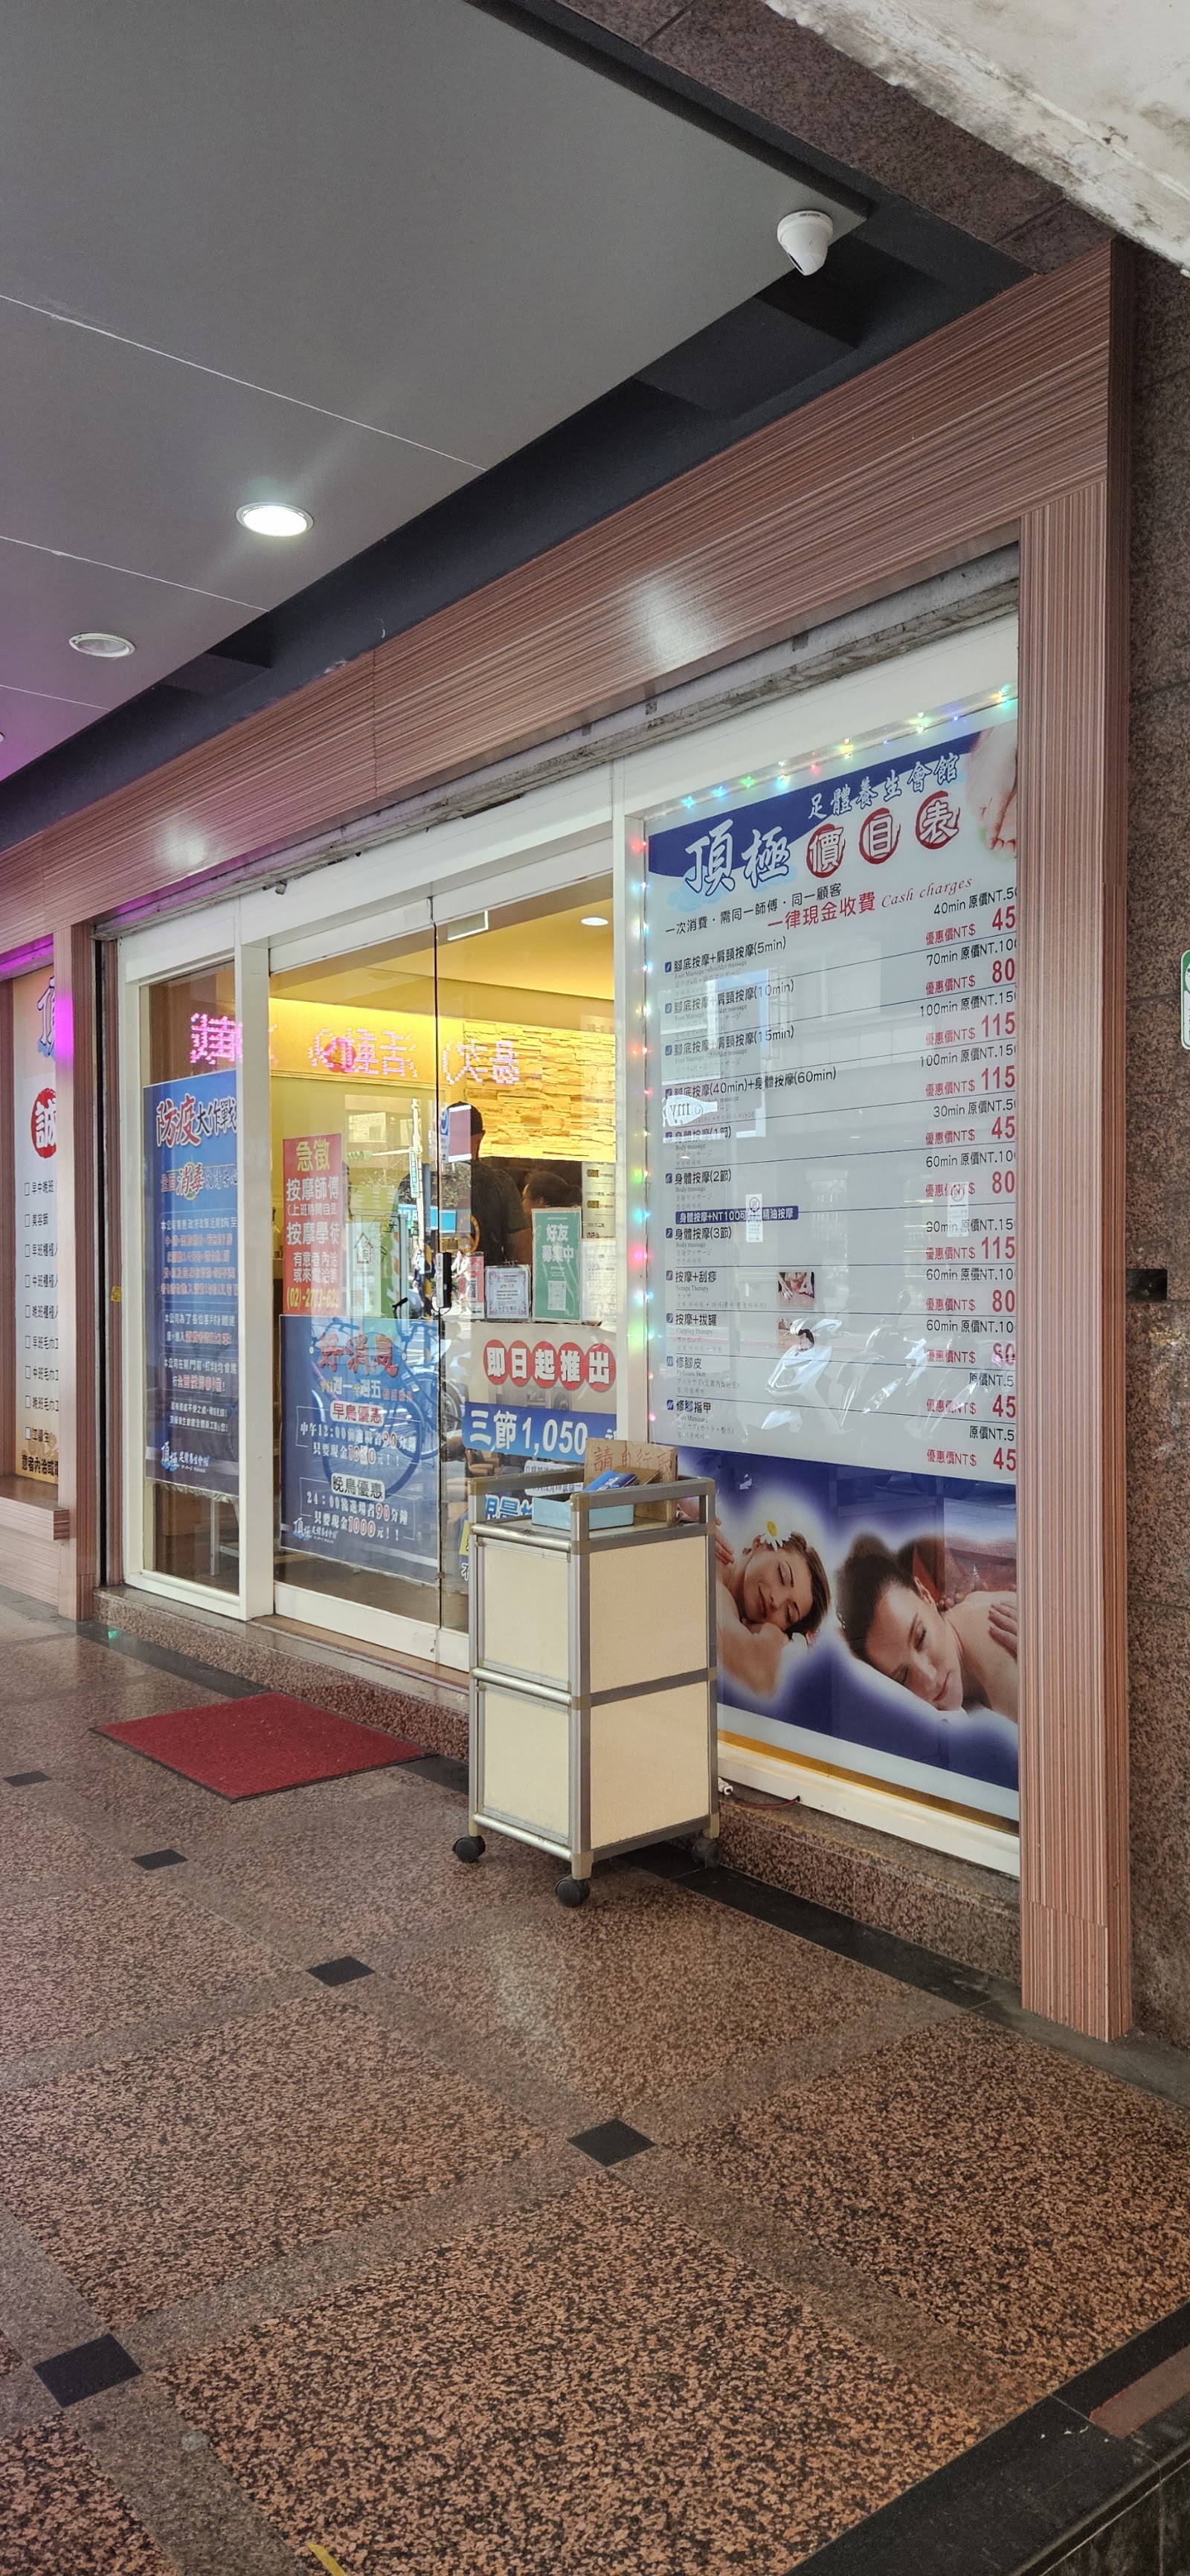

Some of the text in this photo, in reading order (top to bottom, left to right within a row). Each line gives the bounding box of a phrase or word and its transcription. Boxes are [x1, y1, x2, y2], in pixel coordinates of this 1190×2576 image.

[808, 753, 959, 820] 足體養生會館
[685, 796, 959, 896] 頂極 價目表
[768, 879, 973, 930] 一律現金收費 Cash charges
[934, 887, 1017, 915] 40min 原價NT.5
[926, 924, 976, 945] 優惠價NT$
[927, 939, 1017, 966] 70min 原價NT.10
[926, 975, 976, 995] 優惠價NT$
[920, 991, 1016, 1017] 100min 原價NT.15
[920, 1044, 1016, 1067] 100min 原價NT.15
[933, 1099, 1016, 1117] 30min 原價NT.5
[156, 1093, 237, 1148] 防疫大作戰
[926, 1129, 975, 1145] 優惠價NT$
[296, 1139, 330, 1172] 急徵
[926, 1150, 1016, 1167] 60min 原價NT.10
[675, 1169, 732, 1185] 身體按摩(2節)
[286, 1177, 339, 1202] 按摩師傅
[679, 1208, 794, 1223] 身體按摩+NT100可精油按摩
[286, 1221, 339, 1246] 按摩學徒
[546, 1224, 569, 1242] 好友
[675, 1227, 732, 1240] 身體按摩(3節)
[294, 1251, 337, 1268] 有意者內洽
[541, 1244, 574, 1262] 募集中
[927, 1268, 957, 1280] 60min
[926, 1298, 976, 1311] 優惠價NT$
[927, 1320, 958, 1331] 60min
[316, 1332, 399, 1378] 好消息
[485, 1345, 612, 1386] 即日起推出
[676, 1357, 702, 1369] 修腳皮
[332, 1403, 382, 1424] 早鳥優惠
[676, 1400, 711, 1413] 修腳指甲
[469, 1410, 588, 1456] 三節1,050
[927, 1449, 977, 1466] 優惠價NT$
[332, 1475, 383, 1499] 晚鳥優惠
